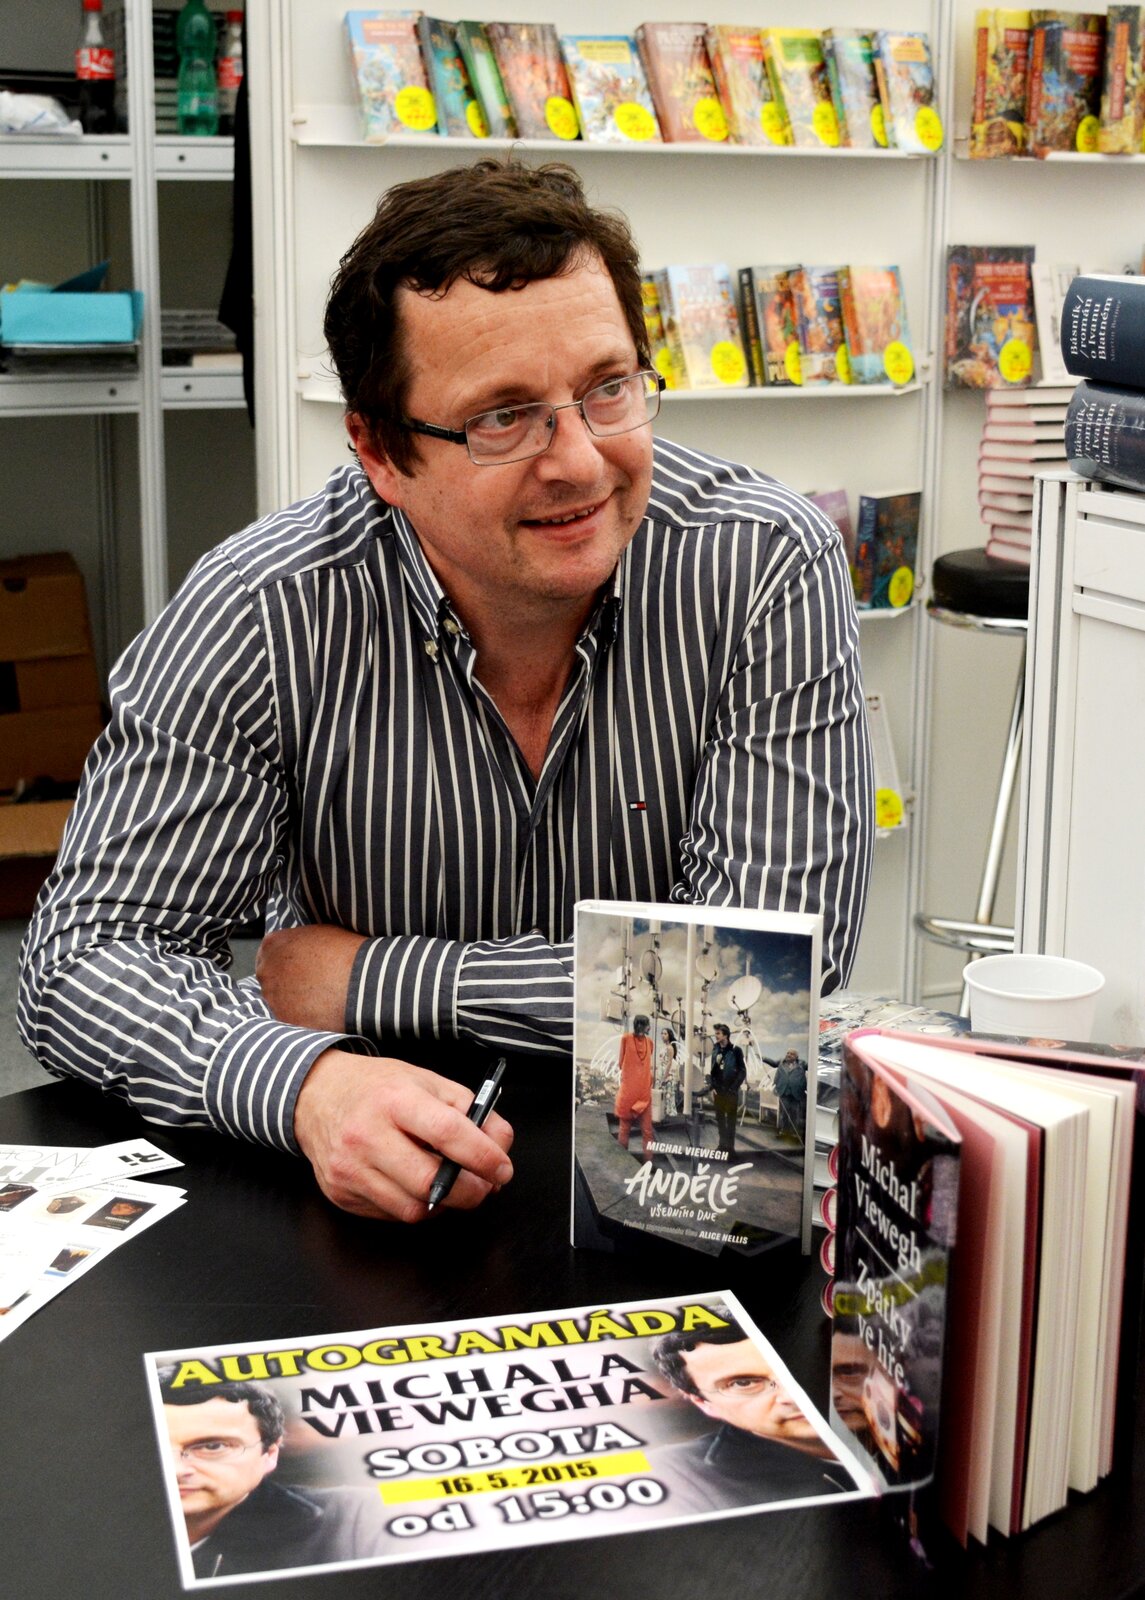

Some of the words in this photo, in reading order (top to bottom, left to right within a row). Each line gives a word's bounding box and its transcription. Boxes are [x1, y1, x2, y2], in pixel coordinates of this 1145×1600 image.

[1088, 303, 1101, 345] Ivanu
[1098, 297, 1113, 360] Blatném
[1092, 408, 1105, 449] Ivanu
[1102, 403, 1117, 464] Blatném
[646, 1141, 683, 1155] MICHAL
[685, 1147, 729, 1161] VIEWEGH
[861, 1134, 918, 1219] Michal
[624, 1160, 754, 1214] ANDĚLÉ
[696, 1209, 718, 1222] DNE
[698, 1230, 721, 1241] ALICE
[721, 1235, 749, 1245] NELLIS
[854, 1172, 922, 1274] Viewegh
[857, 1258, 912, 1351] Zpátky
[857, 1313, 875, 1351] ve
[169, 1304, 730, 1389] AUTOGRAMIÁDA
[299, 1353, 648, 1412] MICHALA
[301, 1377, 669, 1438] VIEWEGHA
[367, 1422, 643, 1479] SOBOTA
[388, 1502, 472, 1537] od
[498, 1477, 666, 1524] 15:00
